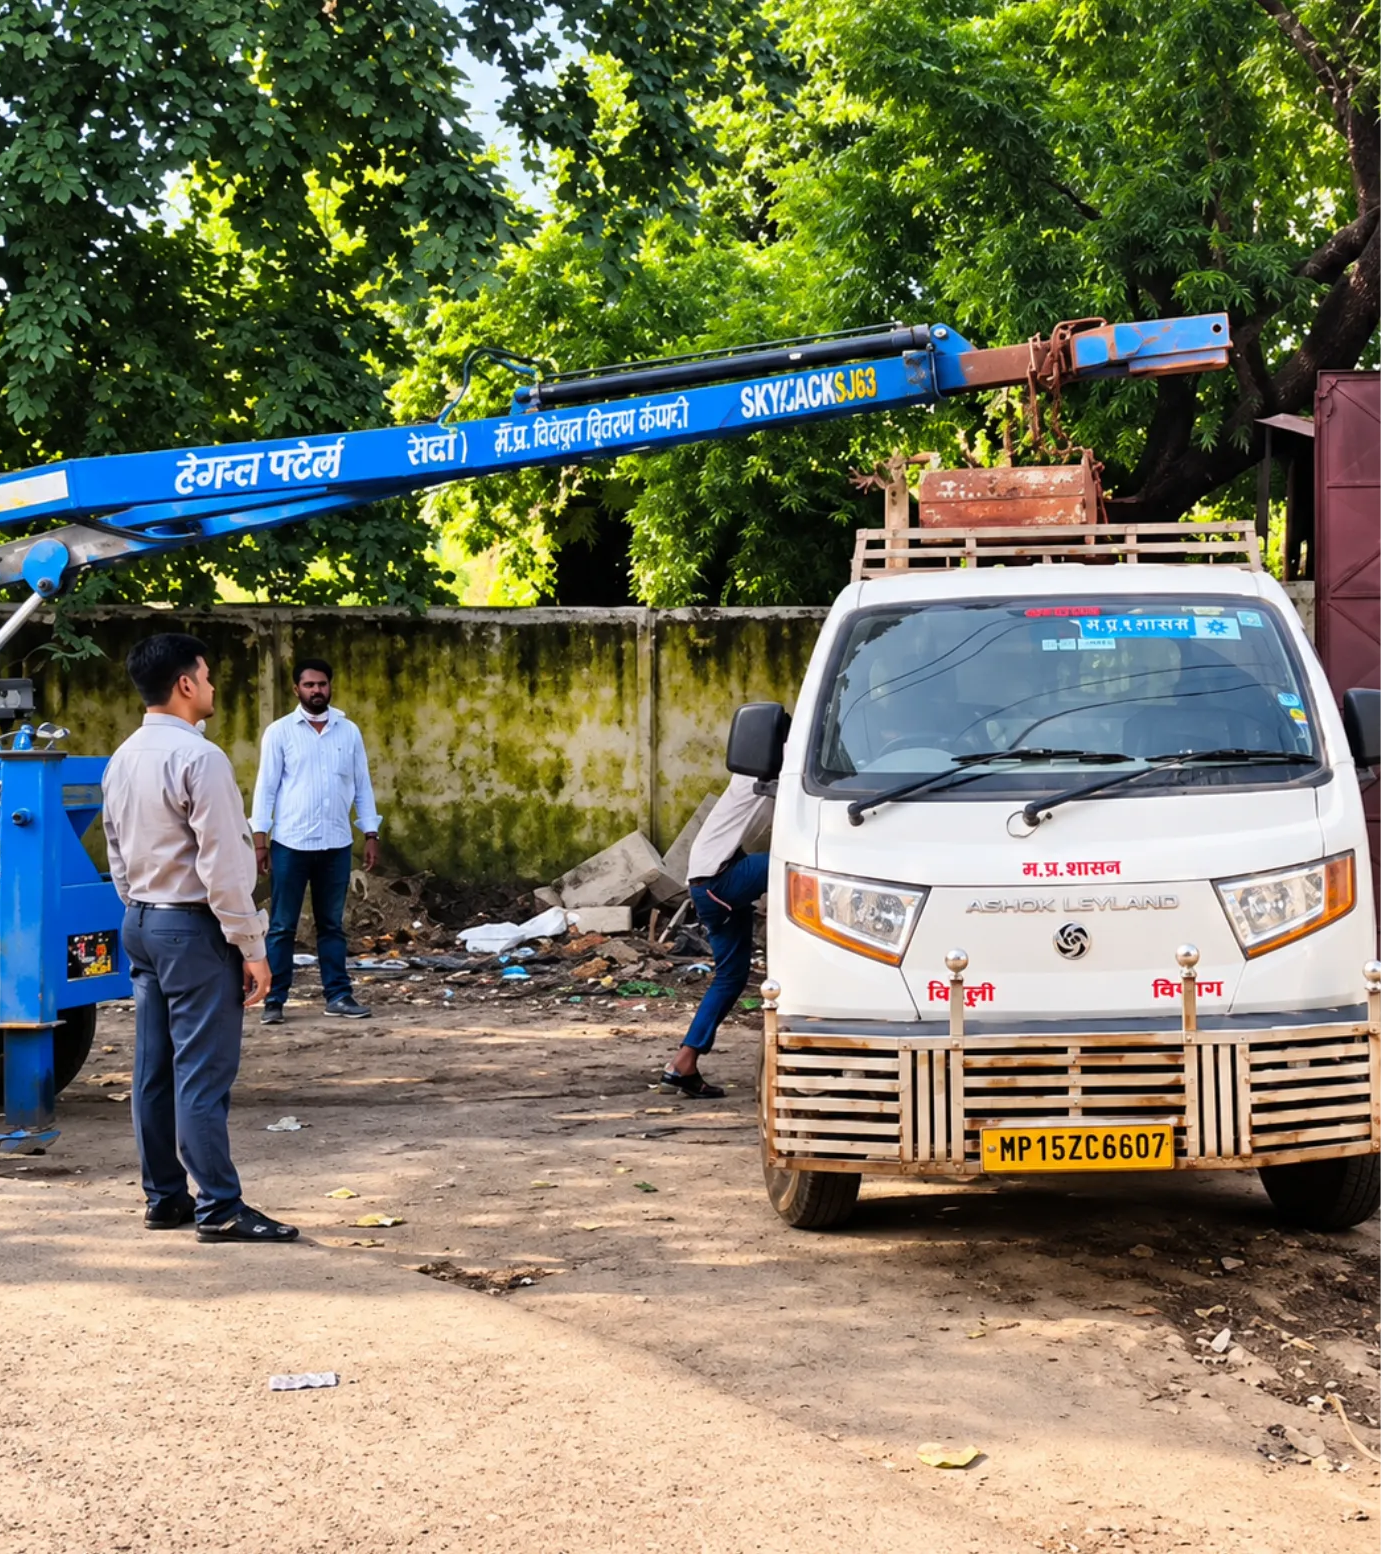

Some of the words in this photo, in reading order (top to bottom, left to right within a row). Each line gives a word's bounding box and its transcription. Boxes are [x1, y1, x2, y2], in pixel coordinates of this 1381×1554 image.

[965, 899, 1056, 914] ASHOK
[1063, 894, 1180, 912] LEYLAND
[999, 1133, 1165, 1161] MP15ZC6607
